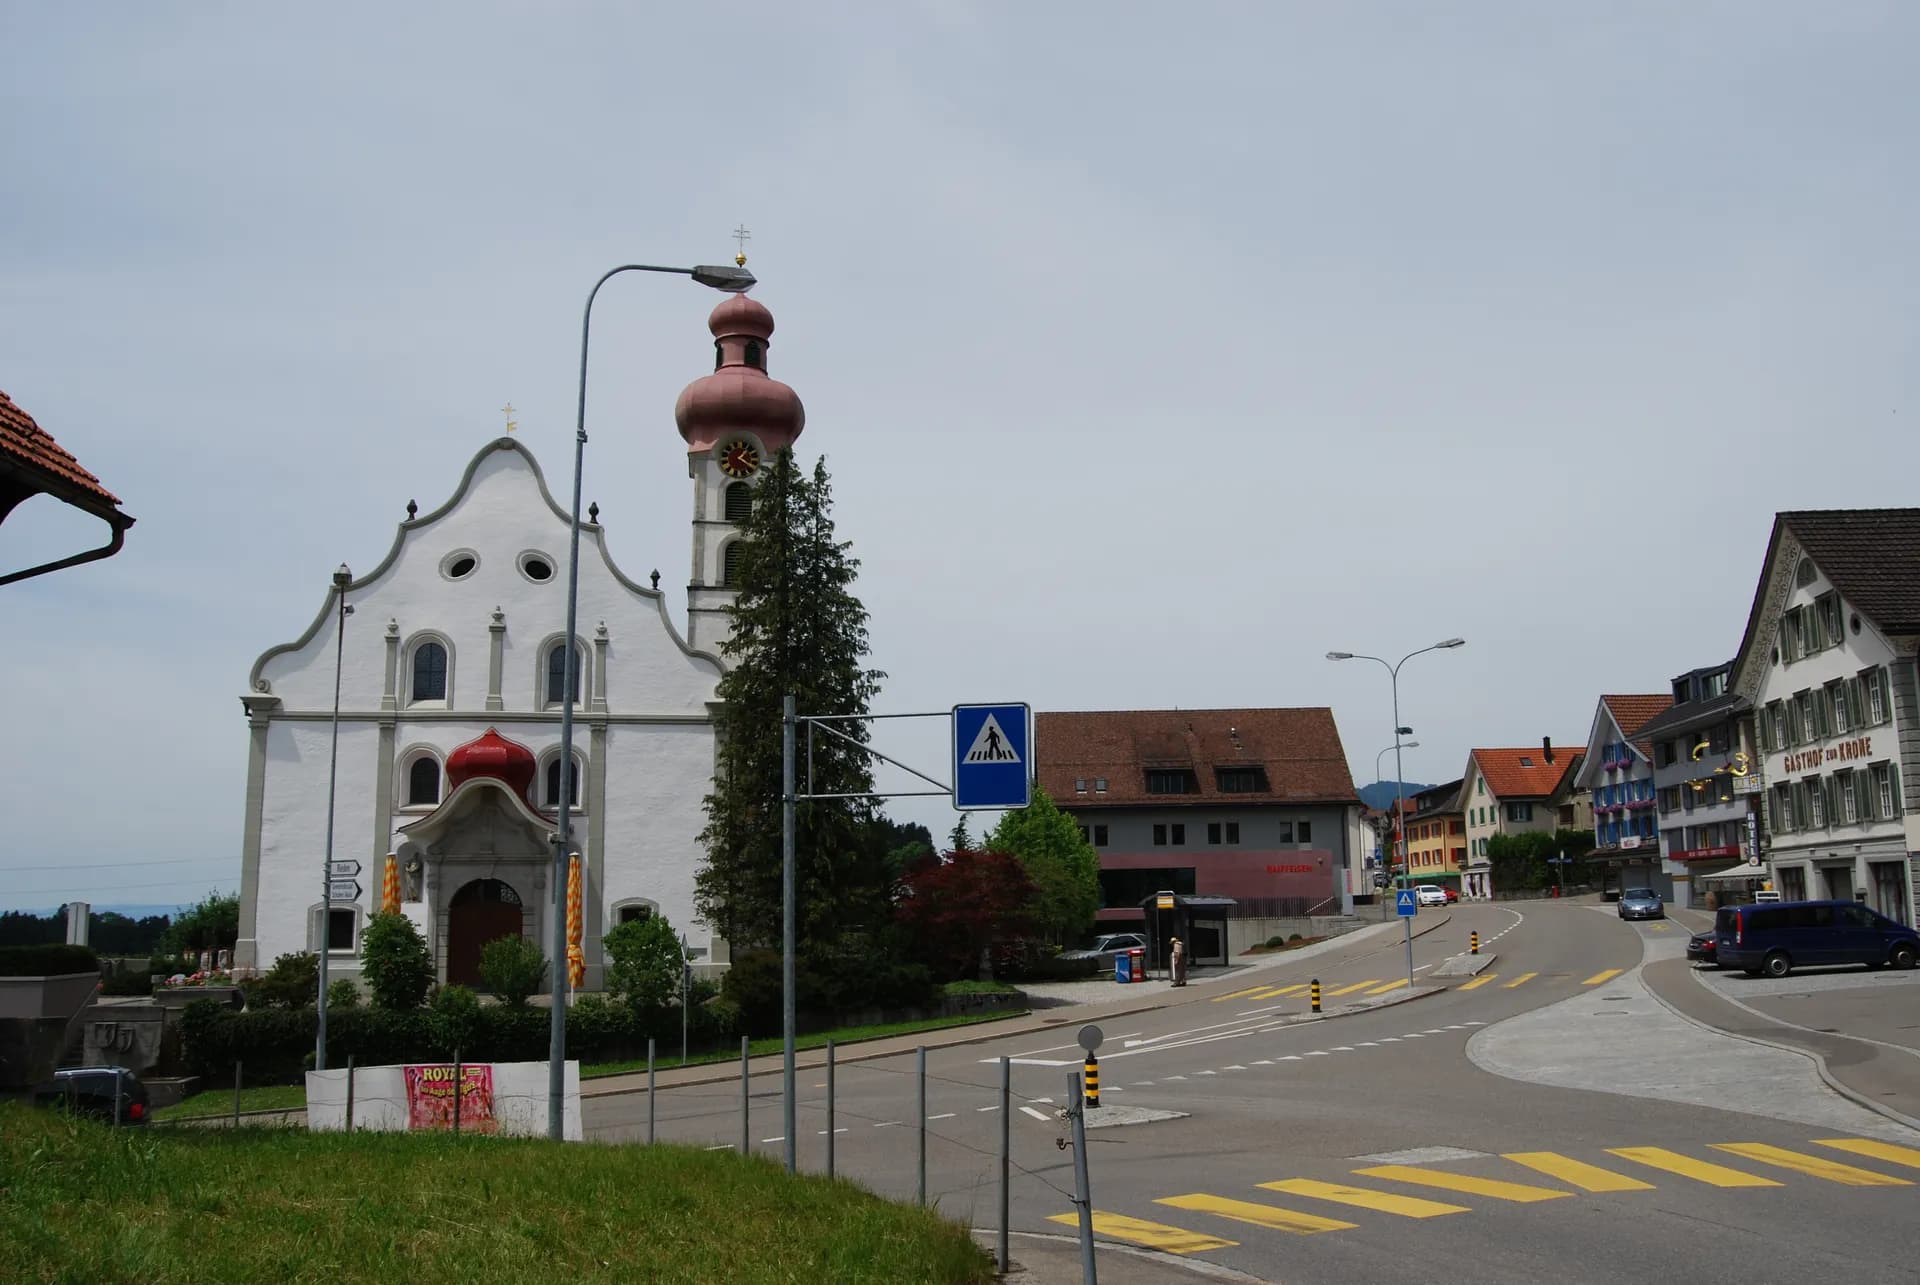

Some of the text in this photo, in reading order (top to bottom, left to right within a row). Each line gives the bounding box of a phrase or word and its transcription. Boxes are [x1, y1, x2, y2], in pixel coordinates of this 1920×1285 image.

[1784, 747, 1823, 774] GASTHOF
[1839, 736, 1872, 762] KRONE
[1747, 812, 1757, 856] HOTEL
